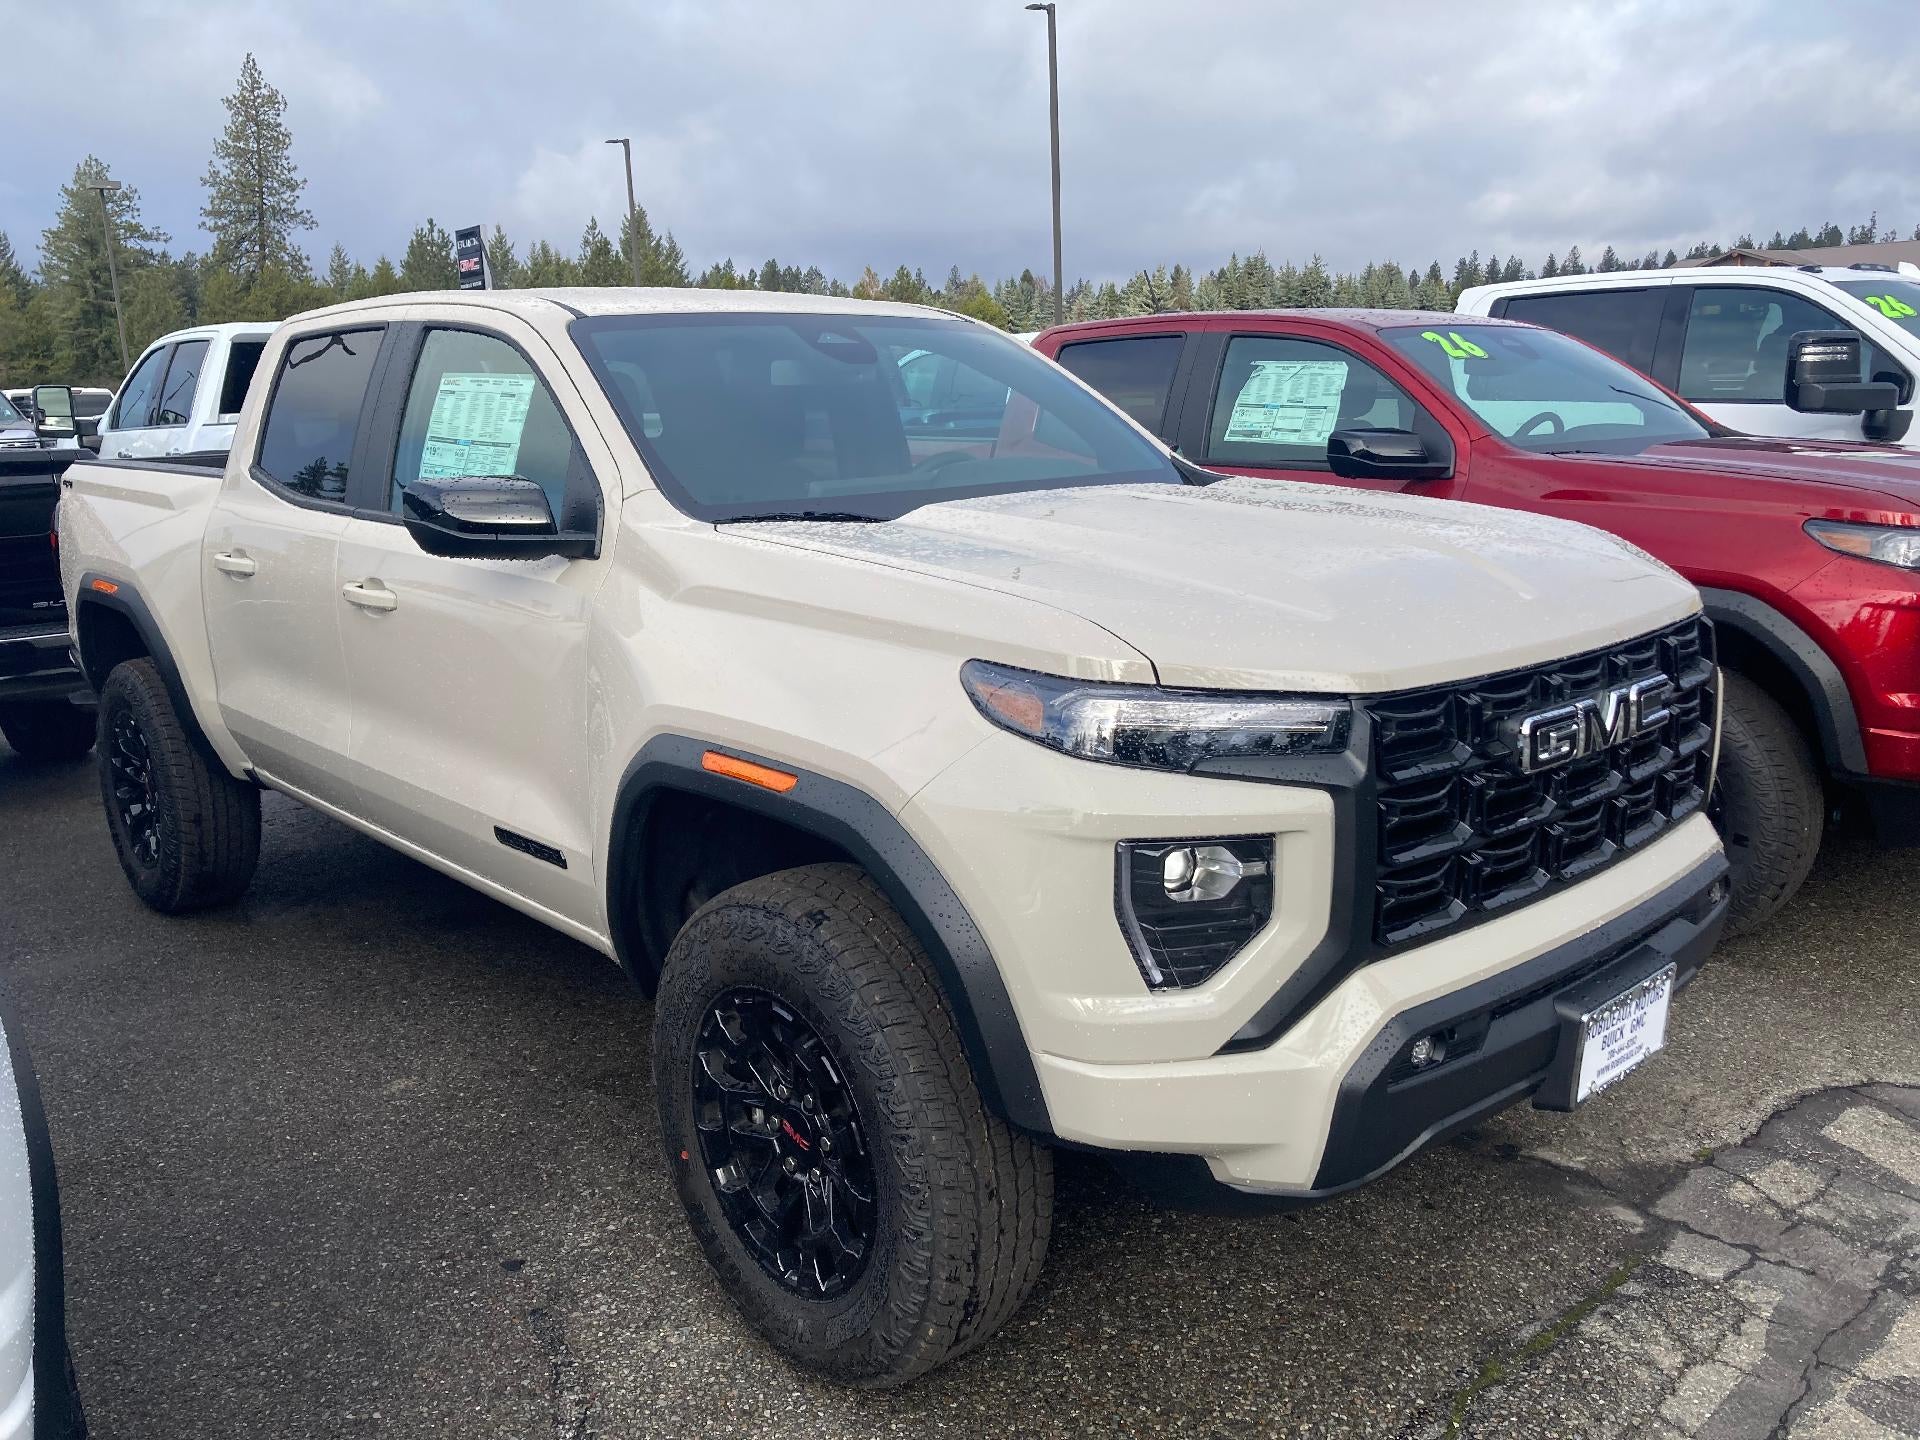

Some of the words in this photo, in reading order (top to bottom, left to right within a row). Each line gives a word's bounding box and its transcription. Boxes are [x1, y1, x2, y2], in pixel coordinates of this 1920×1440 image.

[460, 257, 480, 272] GMC
[1864, 294, 1918, 319] 26
[1421, 331, 1489, 359] 26
[1519, 672, 1674, 775] GMC
[1601, 1024, 1625, 1051] BUICK
[1630, 1011, 1647, 1034] GMC
[782, 1118, 811, 1151] GMC
